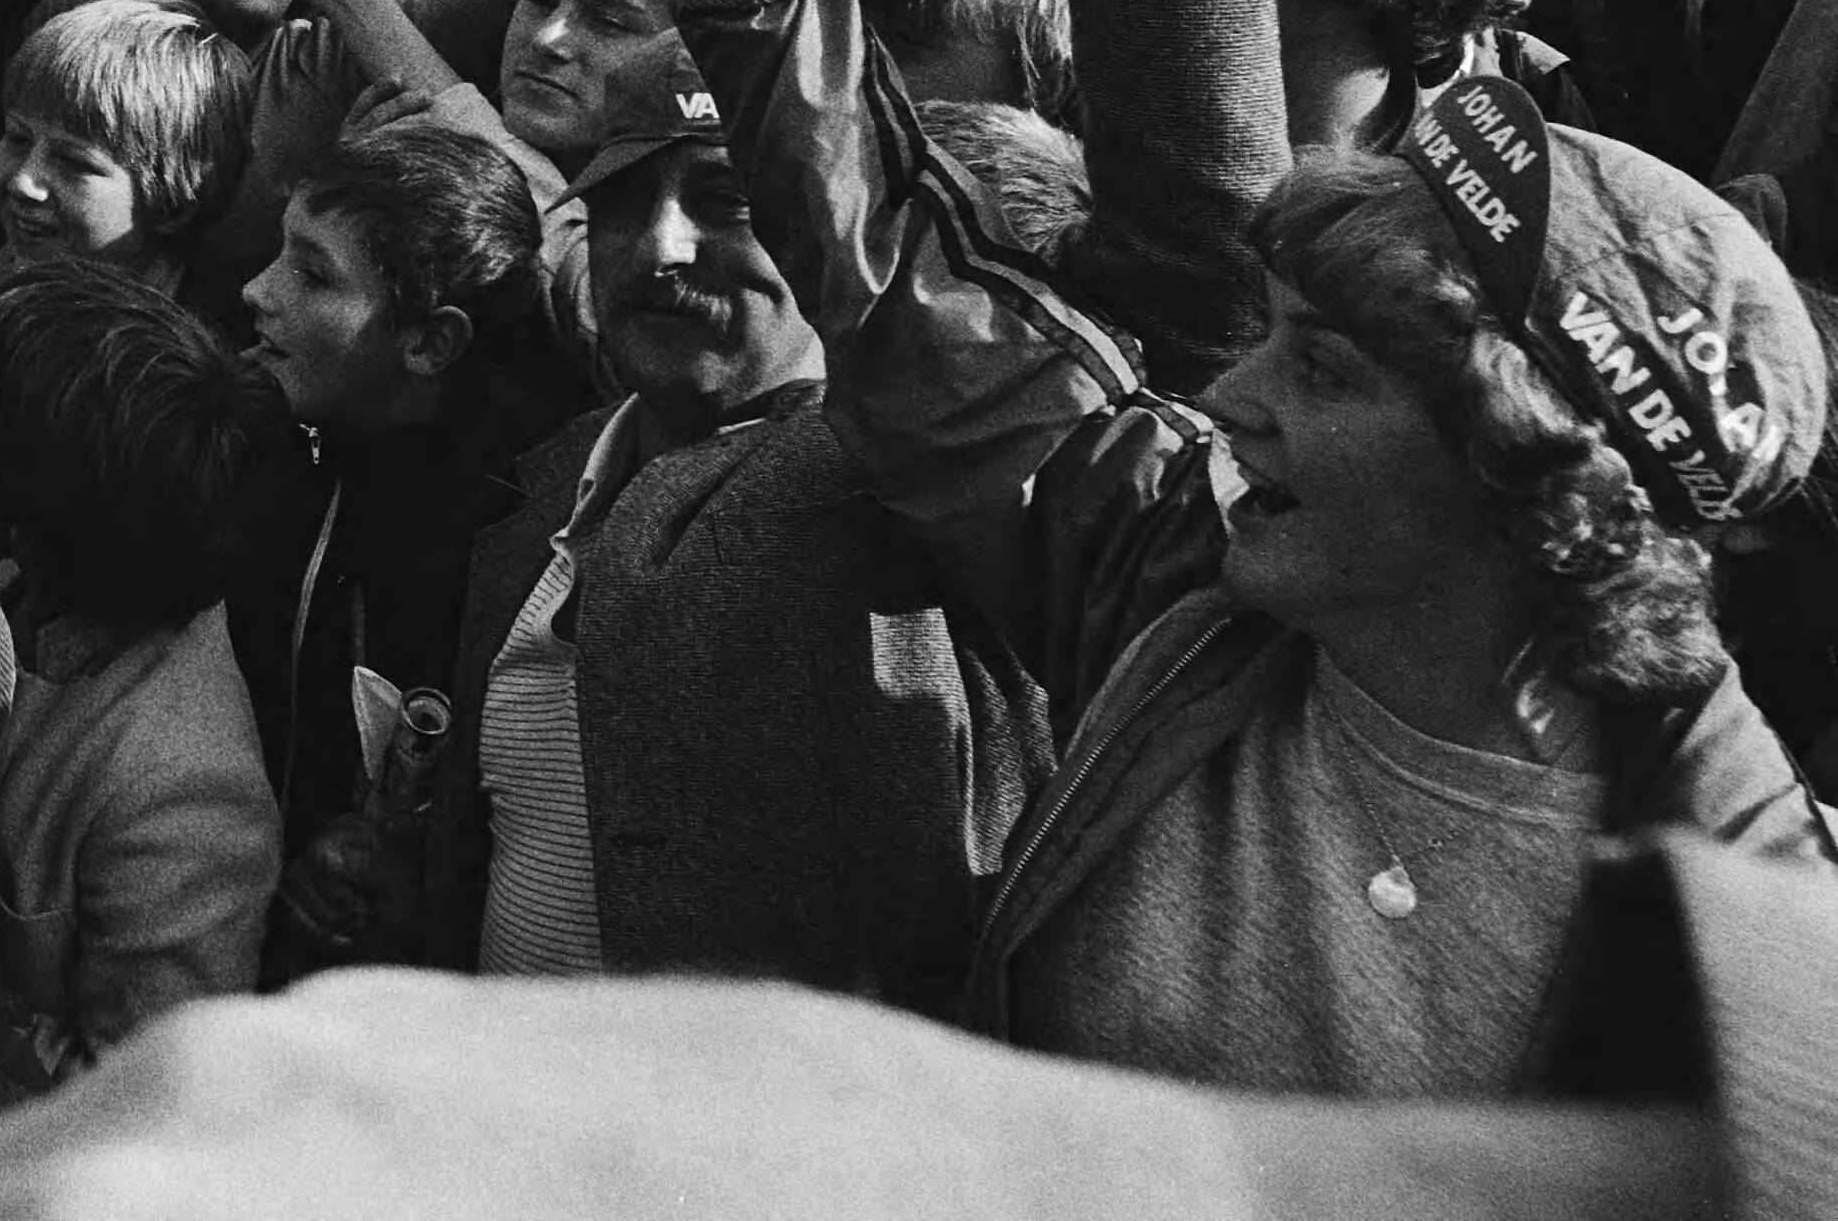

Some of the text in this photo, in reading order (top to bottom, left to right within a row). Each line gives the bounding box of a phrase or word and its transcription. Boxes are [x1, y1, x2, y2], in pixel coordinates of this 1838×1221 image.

[1456, 85, 1539, 174] JOHAN
[1423, 133, 1461, 169] DE
[1445, 158, 1522, 244] VELDE
[1558, 290, 1652, 396] VAN
[1628, 388, 1693, 452] DE
